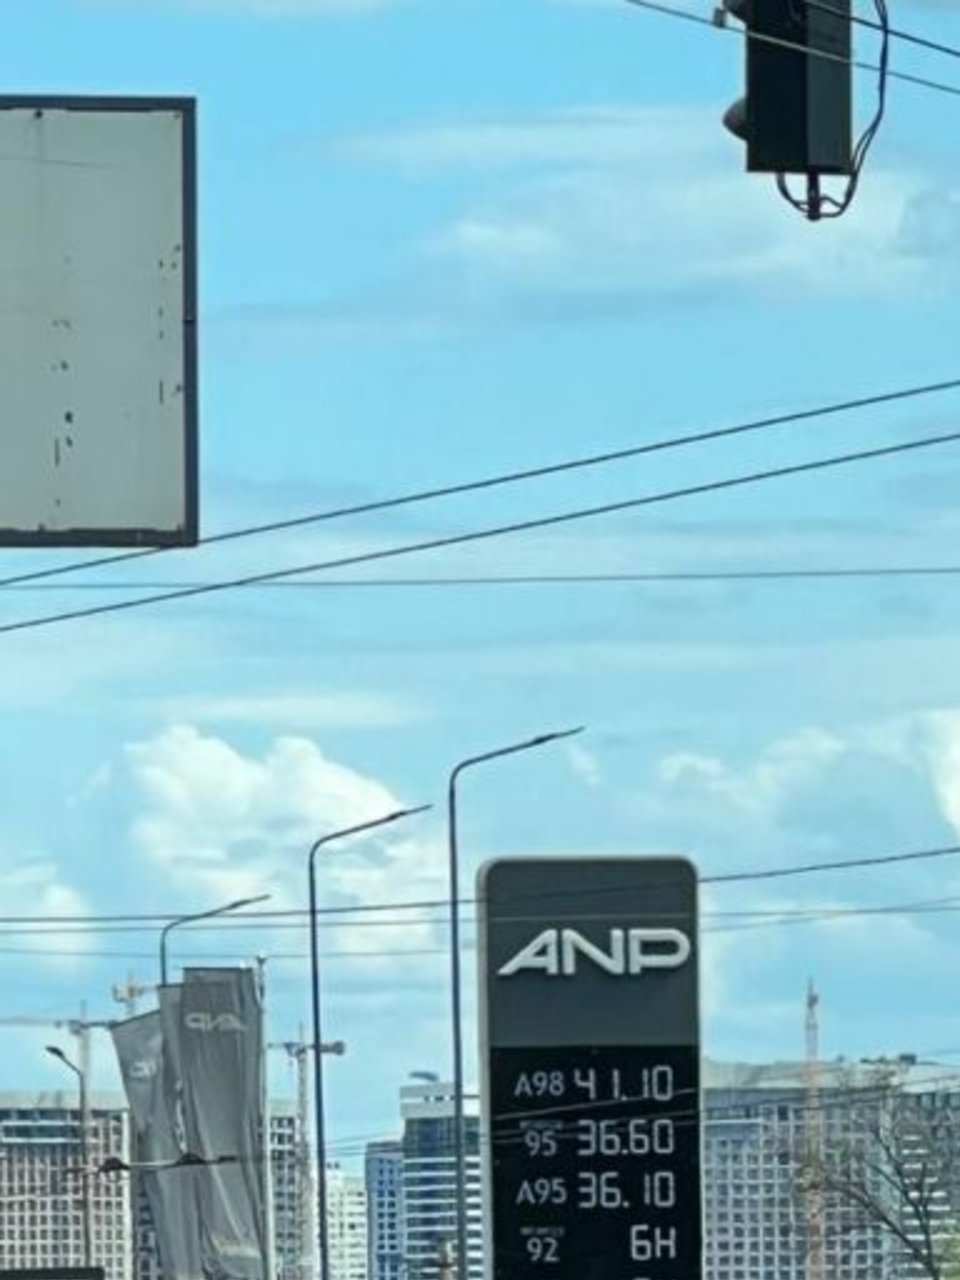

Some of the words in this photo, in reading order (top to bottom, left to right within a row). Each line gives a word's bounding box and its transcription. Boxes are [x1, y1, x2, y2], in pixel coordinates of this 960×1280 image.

[498, 928, 691, 976] ANP
[573, 1065, 674, 1101] 41.10
[524, 1131, 557, 1156] 95
[577, 1119, 674, 1155] 36.60
[578, 1171, 676, 1208] 36.10
[526, 1237, 560, 1262] 92
